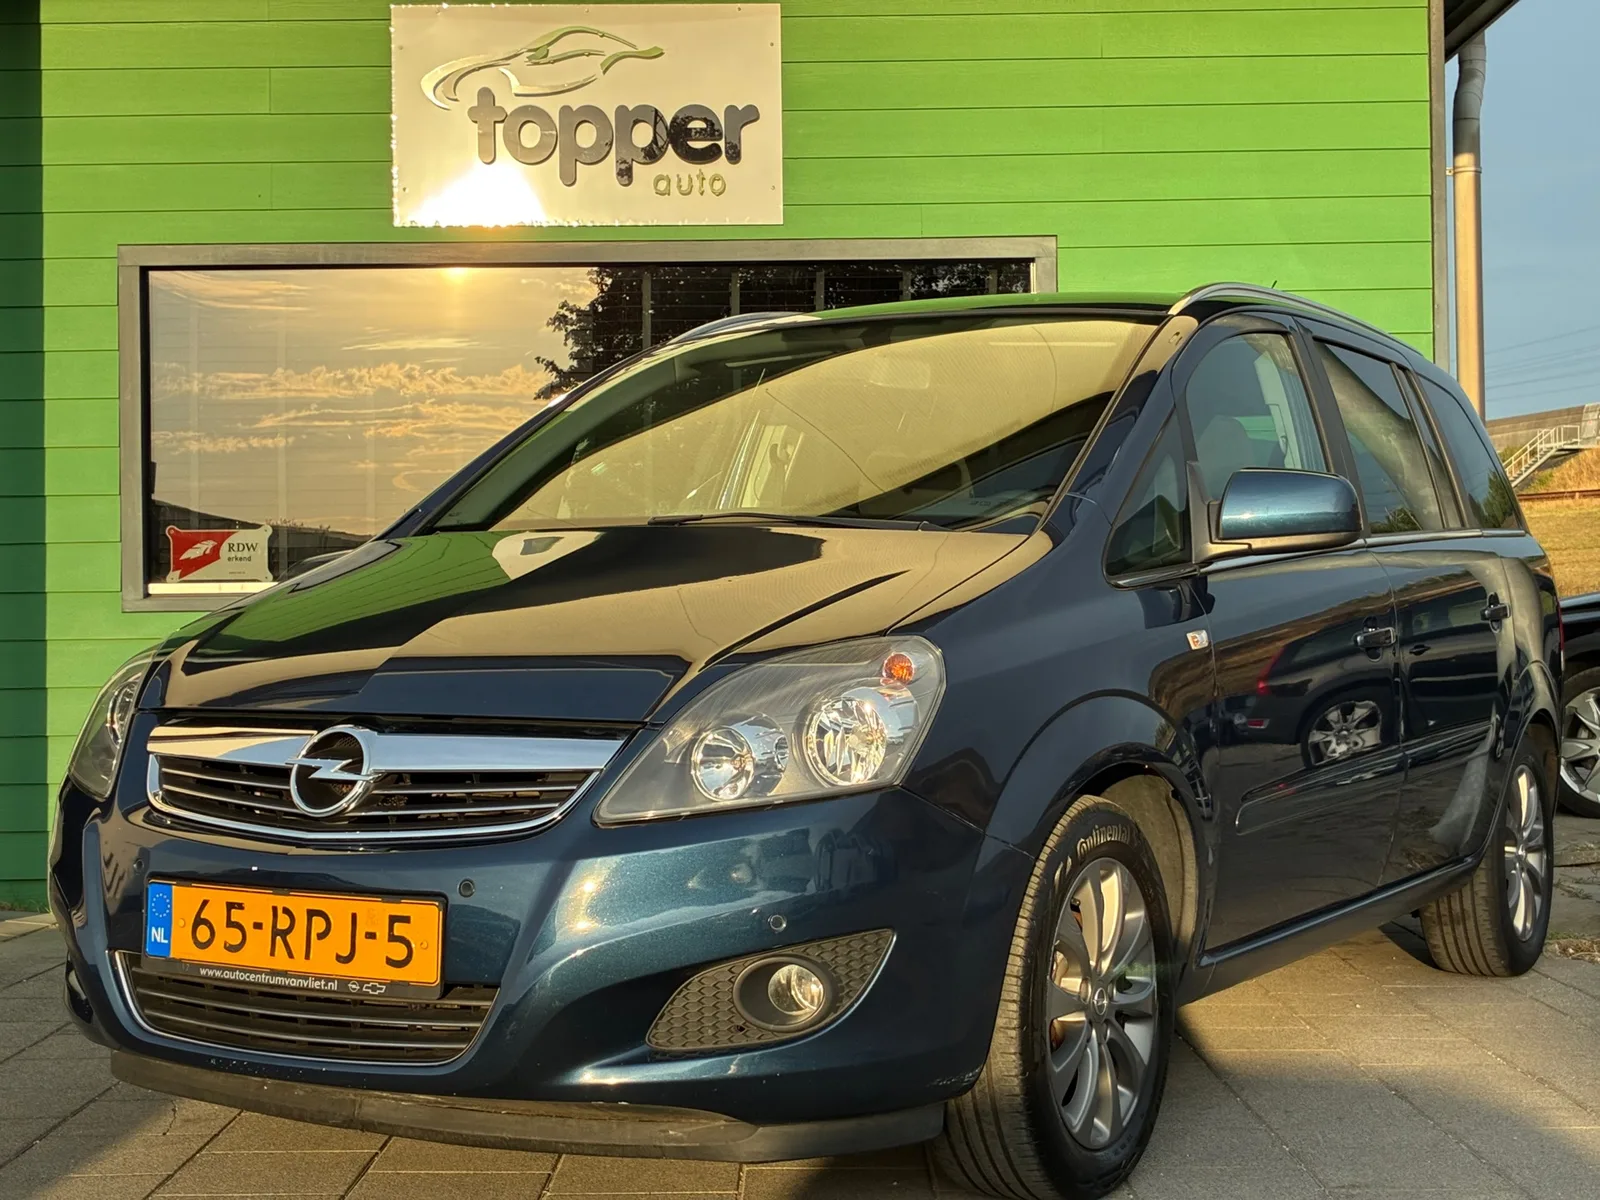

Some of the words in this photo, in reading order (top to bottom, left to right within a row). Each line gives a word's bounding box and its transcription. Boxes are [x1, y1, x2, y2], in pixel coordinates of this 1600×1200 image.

[467, 87, 760, 186] topper
[652, 170, 727, 197] auto
[228, 542, 258, 553] RDW
[151, 926, 168, 943] NL
[191, 899, 414, 969] 65-RPJ-5
[199, 966, 338, 991] www.autocentrumvanvliet.nl
